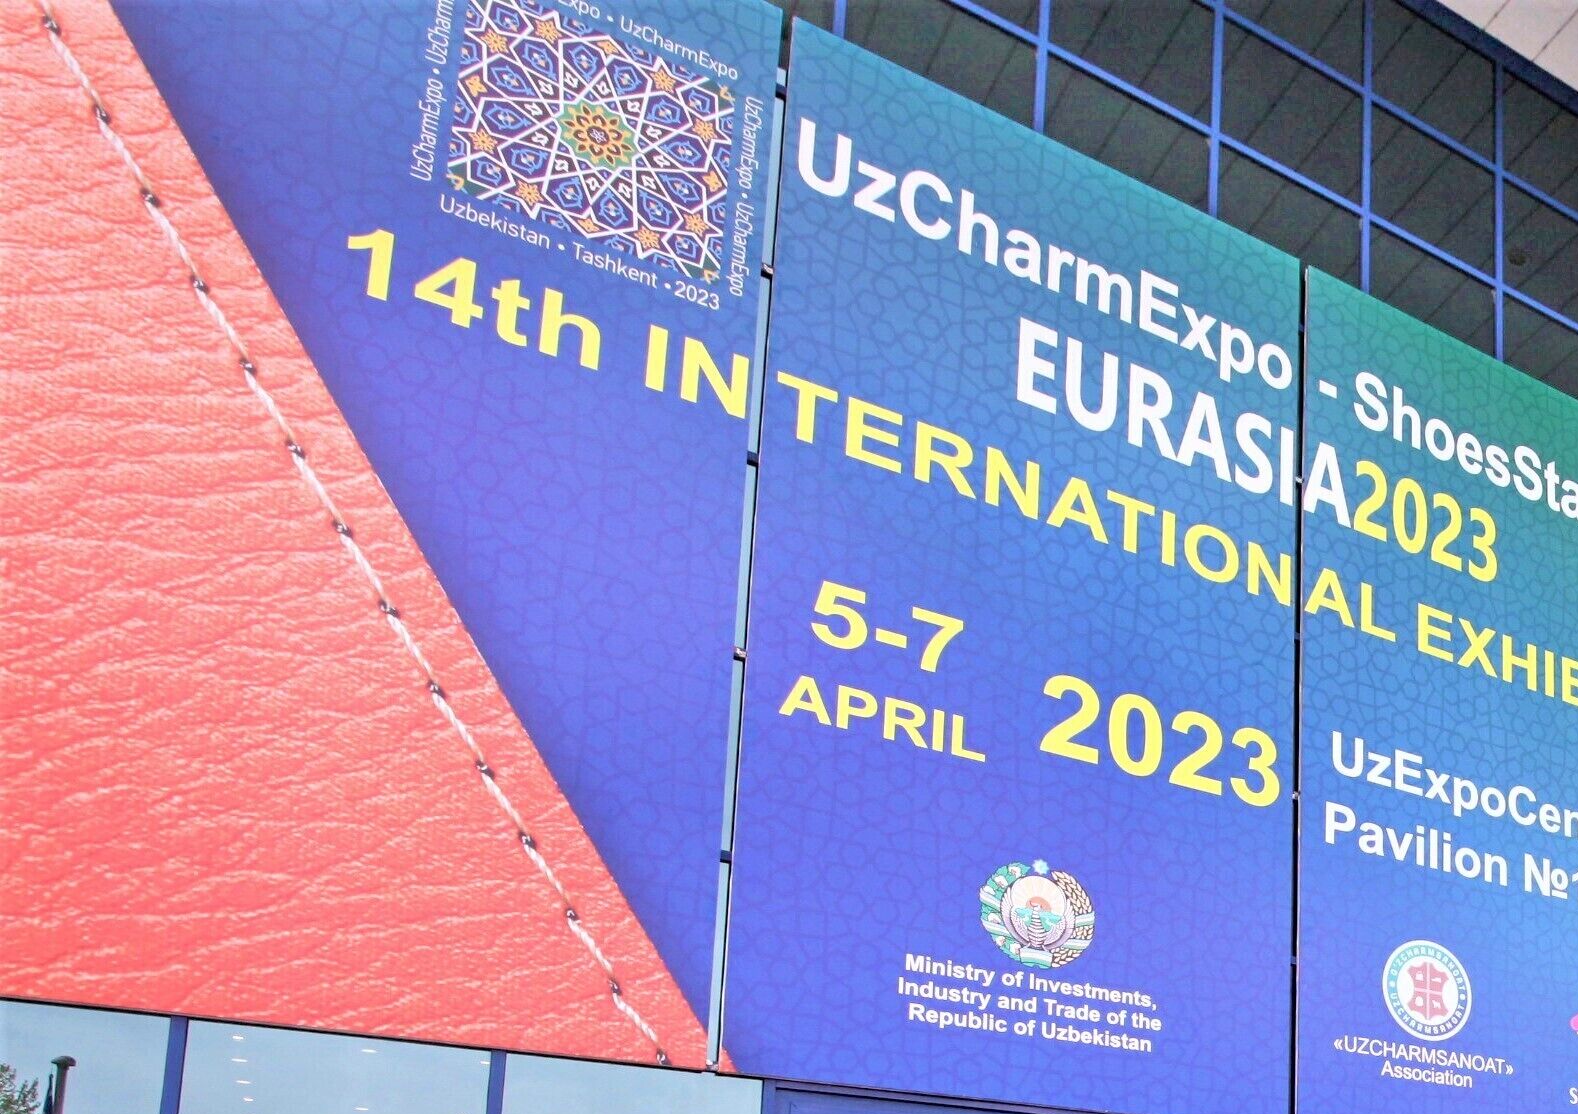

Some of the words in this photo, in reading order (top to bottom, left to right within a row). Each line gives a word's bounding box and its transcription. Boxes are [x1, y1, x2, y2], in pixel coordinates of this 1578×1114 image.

[620, 15, 738, 80] UzCharmExpo
[410, 78, 447, 182] UzCharmExpo
[736, 96, 763, 190] UzCharmExpo
[440, 194, 550, 250] Uzbekistan
[572, 242, 658, 289] Tashkent
[673, 280, 720, 311] 2023
[727, 202, 754, 297] UzCharmExpo
[798, 117, 1293, 391] UzCharmExpo
[348, 229, 602, 371] 14th
[644, 325, 1397, 642] INTERNATIONAL
[810, 580, 964, 673] 5-7
[779, 675, 986, 763] APRIL
[1039, 674, 1280, 807] 2023
[1324, 800, 1509, 888] Pavilion
[897, 976, 991, 1011] Industry
[997, 995, 1038, 1014] and
[1043, 998, 1101, 1023] Trade
[1106, 1009, 1128, 1026] of
[1130, 1012, 1163, 1032] the
[905, 953, 996, 988] Ministry
[1001, 971, 1025, 988] of
[1029, 972, 1157, 1011] Investments,
[907, 1002, 1008, 1033] Republic
[1013, 1019, 1037, 1037] of
[1041, 1021, 1153, 1053] Uzbekistan
[1380, 1059, 1473, 1089] Association
